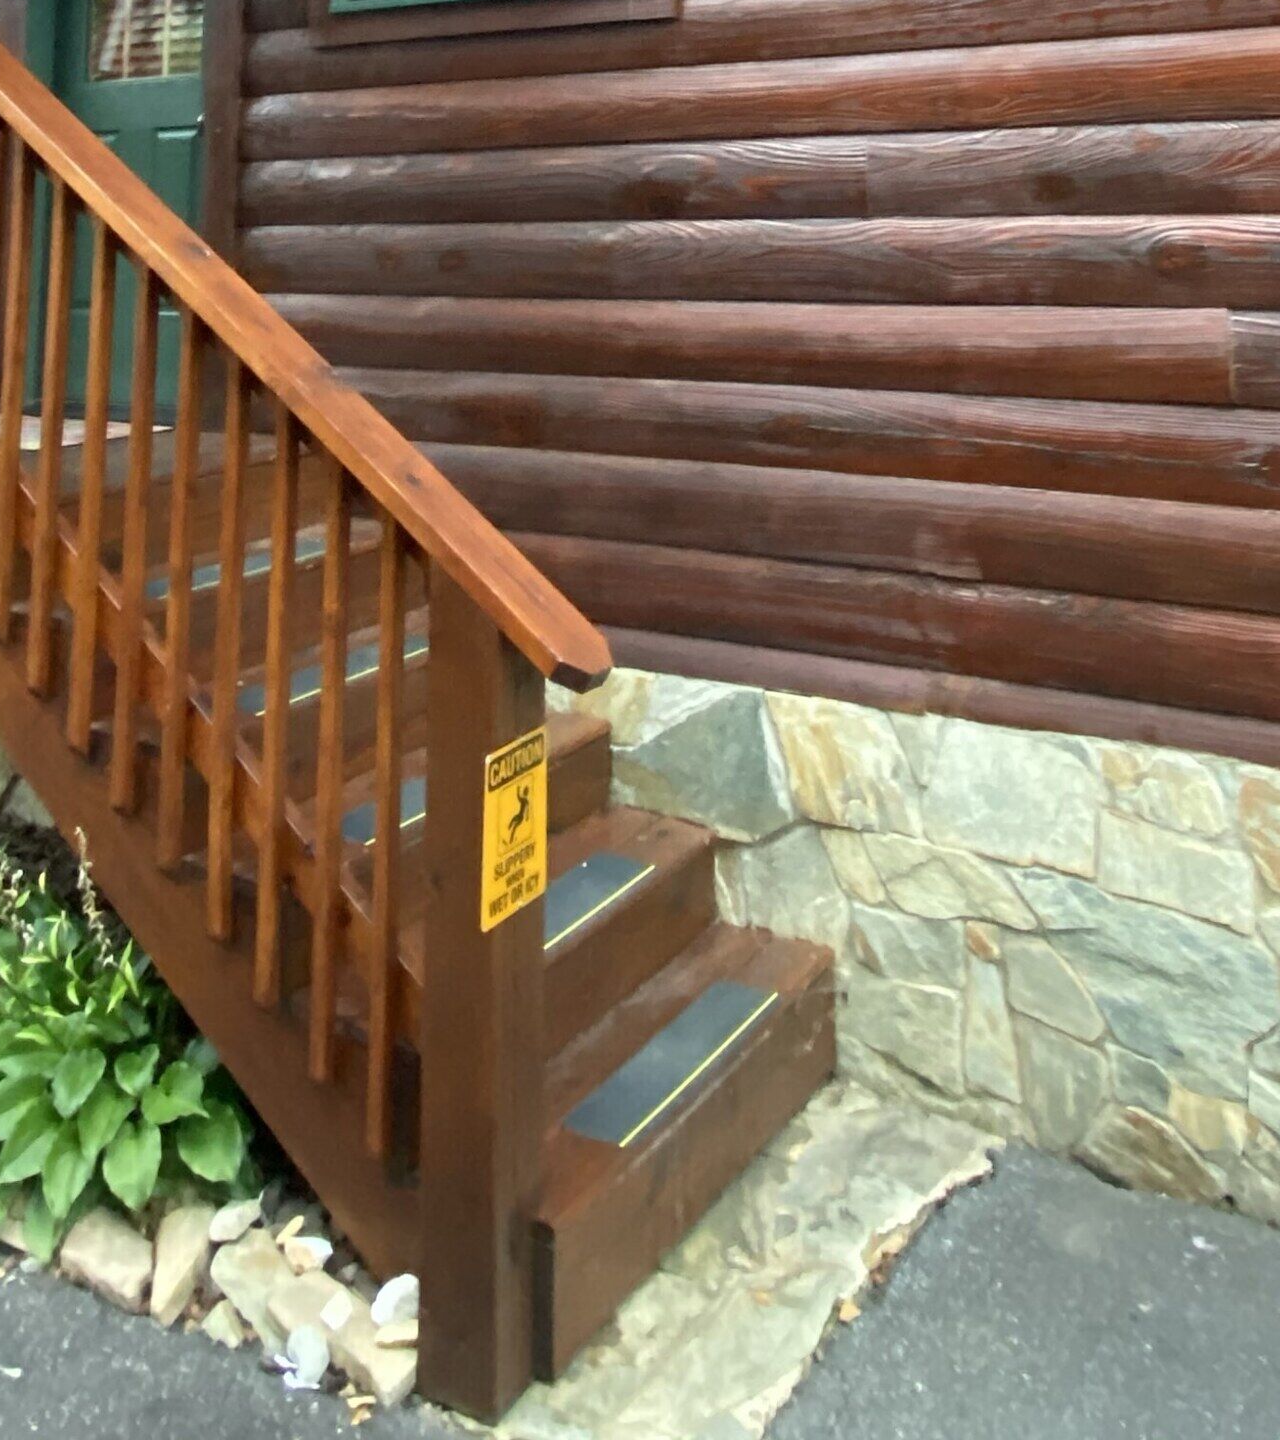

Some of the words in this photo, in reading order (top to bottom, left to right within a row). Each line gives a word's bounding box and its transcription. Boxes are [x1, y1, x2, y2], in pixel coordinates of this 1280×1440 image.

[490, 737, 543, 787] CAUTION
[494, 843, 535, 880] SLIPPERY
[489, 892, 508, 918] WET
[511, 883, 523, 904] OR
[526, 873, 539, 894] ICY
